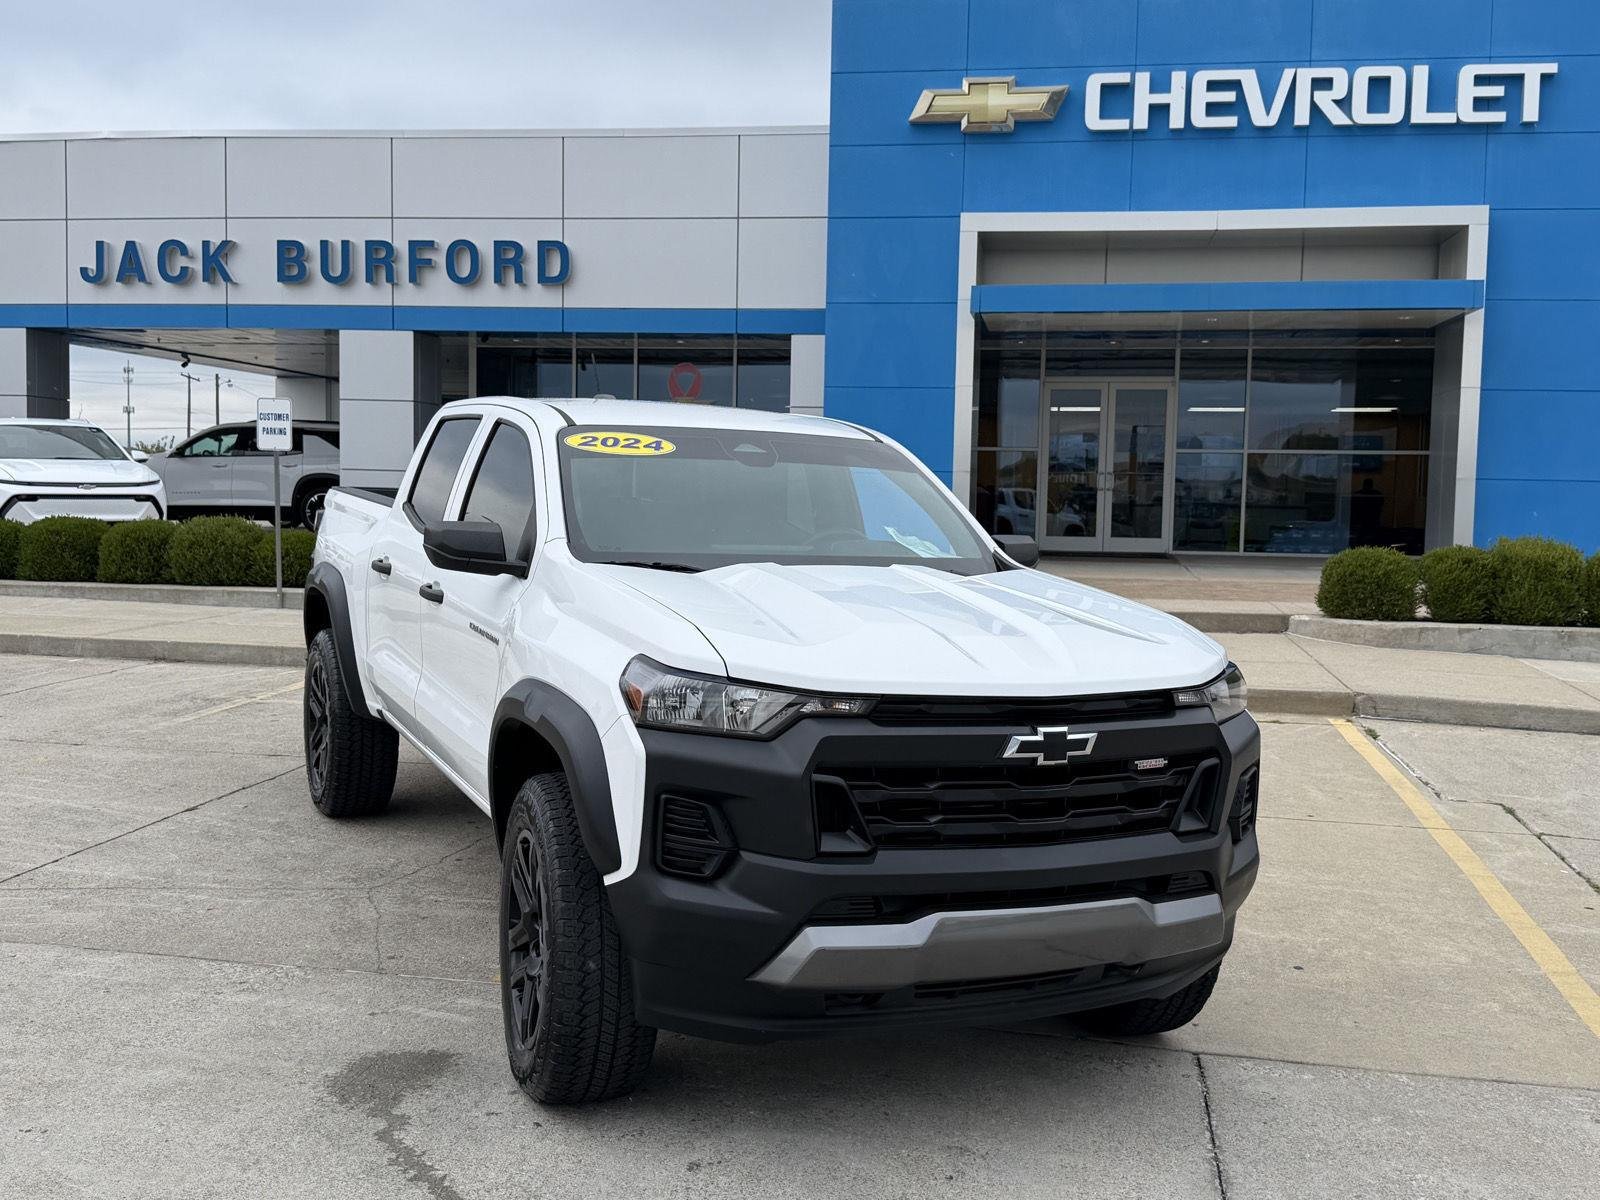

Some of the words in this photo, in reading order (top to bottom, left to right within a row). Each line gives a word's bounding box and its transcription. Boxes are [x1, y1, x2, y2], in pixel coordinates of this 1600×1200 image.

[1085, 62, 1558, 131] CHEVROLET
[80, 239, 236, 285] JACK
[277, 239, 571, 285] BURFORD
[260, 412, 289, 421] CUSTOMER
[262, 426, 287, 435] PARKING
[577, 436, 663, 451] 2024
